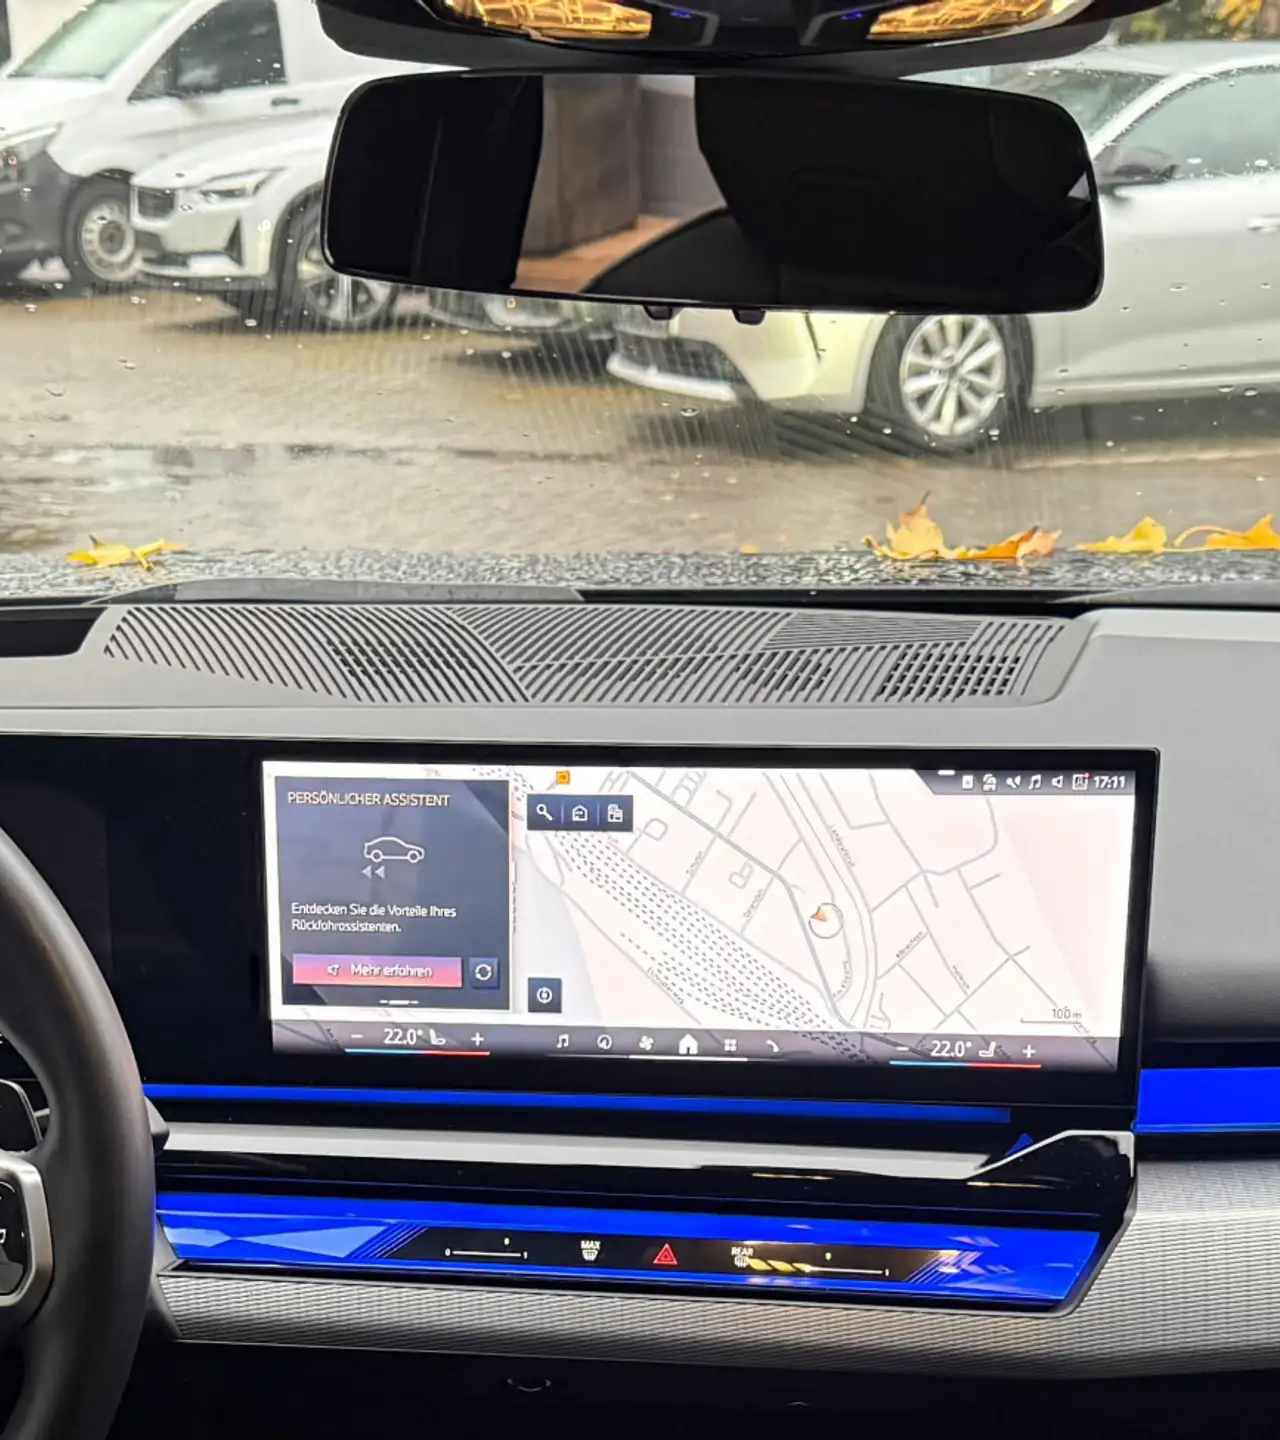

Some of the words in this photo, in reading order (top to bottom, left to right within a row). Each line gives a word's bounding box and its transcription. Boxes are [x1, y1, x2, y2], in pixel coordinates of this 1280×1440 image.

[1093, 775, 1126, 788] 17:11
[287, 790, 381, 805] PERSÖNLICHER
[383, 793, 451, 806] ASSISTENT
[291, 902, 347, 915] Entdecken
[350, 904, 367, 916] Sie
[369, 904, 385, 917] die
[387, 905, 428, 917] Vorteile
[430, 906, 457, 918] Ihres
[350, 963, 381, 976] Mehr
[383, 965, 433, 978] erfahren
[1052, 1007, 1071, 1019] 100
[384, 1027, 423, 1045] 22.0°
[930, 1040, 973, 1057] 22.0°
[581, 1240, 601, 1250] MAX
[731, 1247, 754, 1257] REAR
